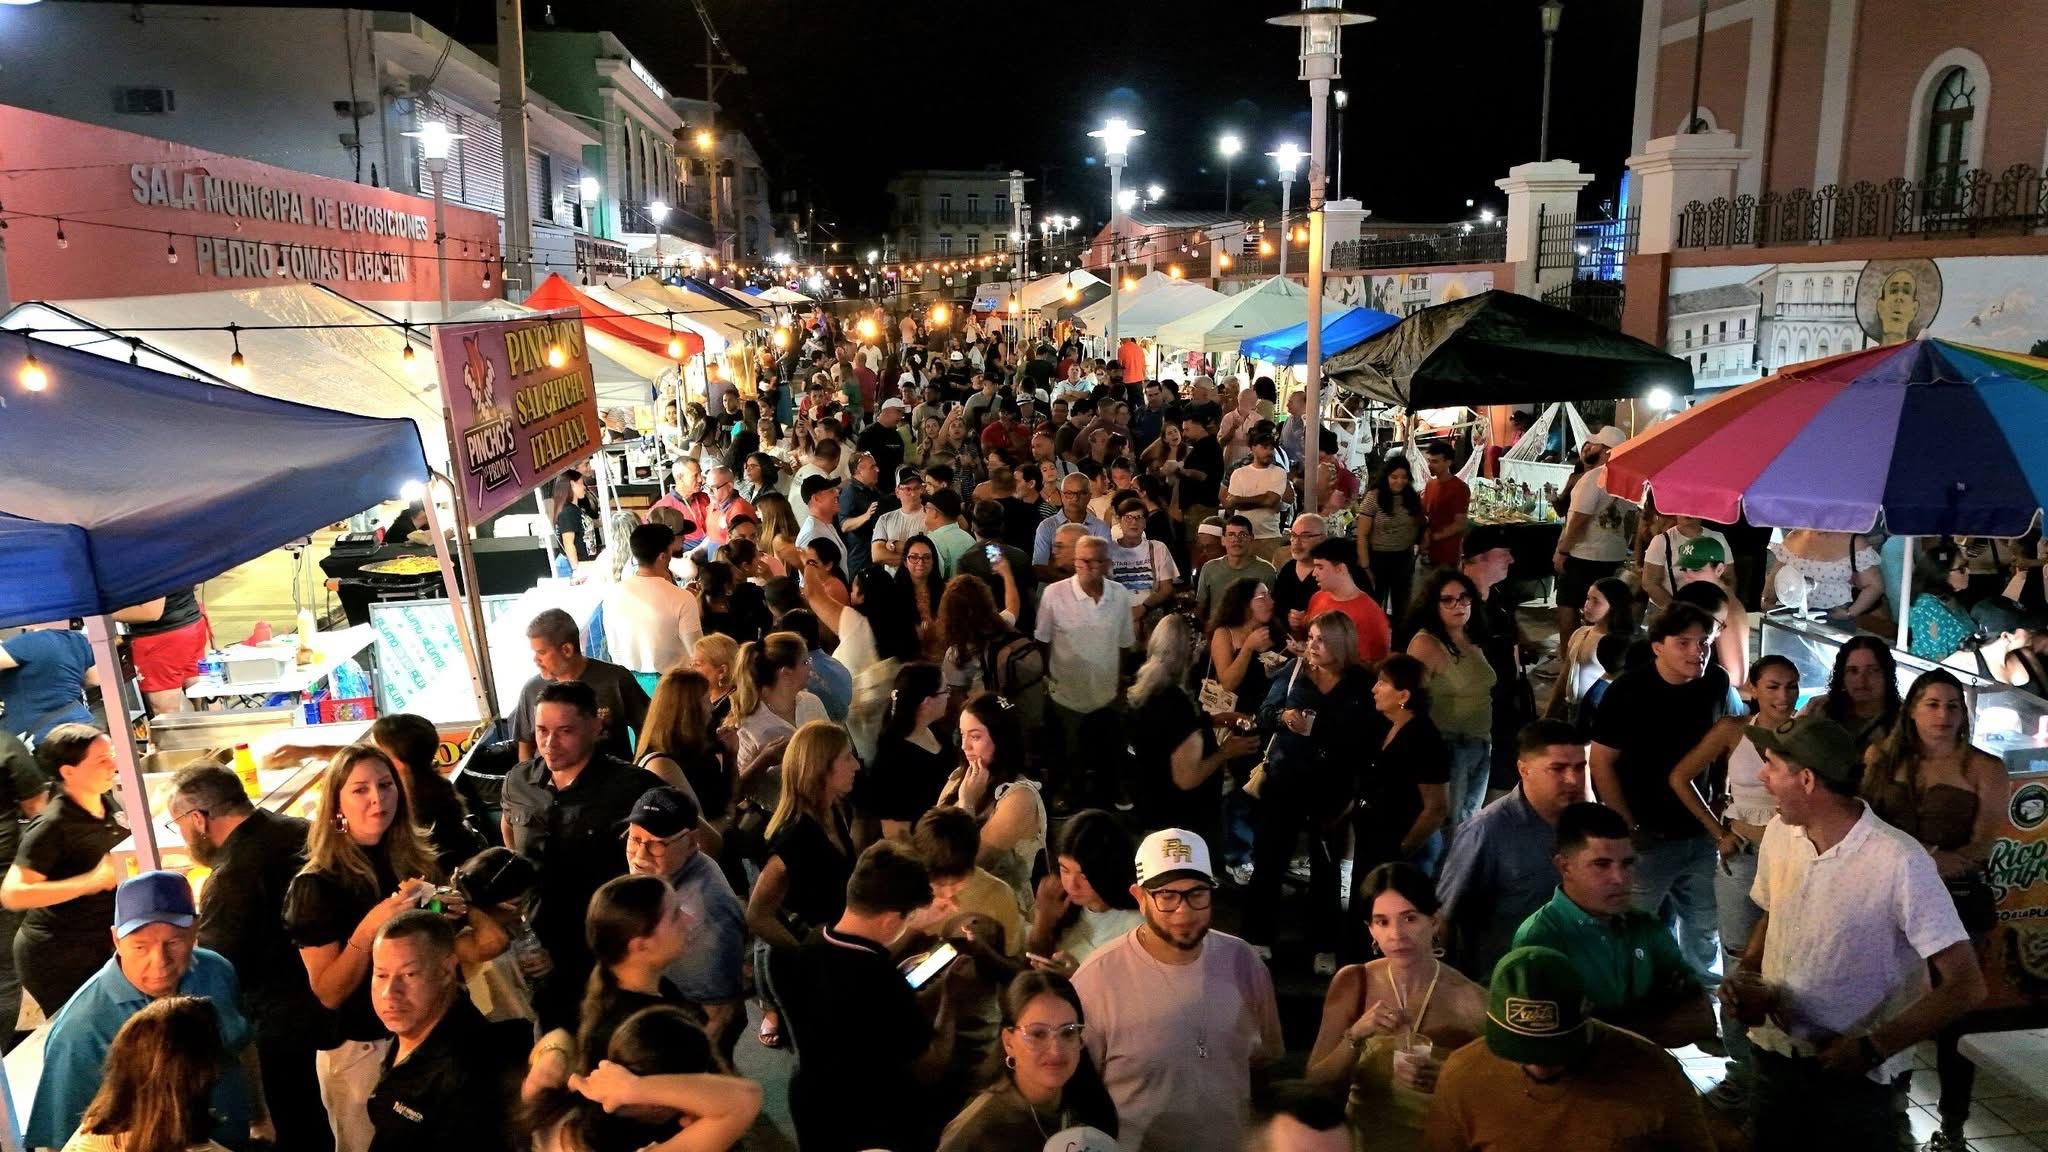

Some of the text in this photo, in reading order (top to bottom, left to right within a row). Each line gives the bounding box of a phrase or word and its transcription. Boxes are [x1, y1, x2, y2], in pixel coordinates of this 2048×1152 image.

[131, 163, 429, 241] SALA MUNICIPAL DE EXPOSICIONES
[196, 236, 272, 279] PEDRO
[275, 241, 342, 281] TOMAS
[516, 371, 587, 426] SALCHICHA
[466, 420, 515, 467] PINCHO'S
[529, 414, 590, 471] ITALIANA
